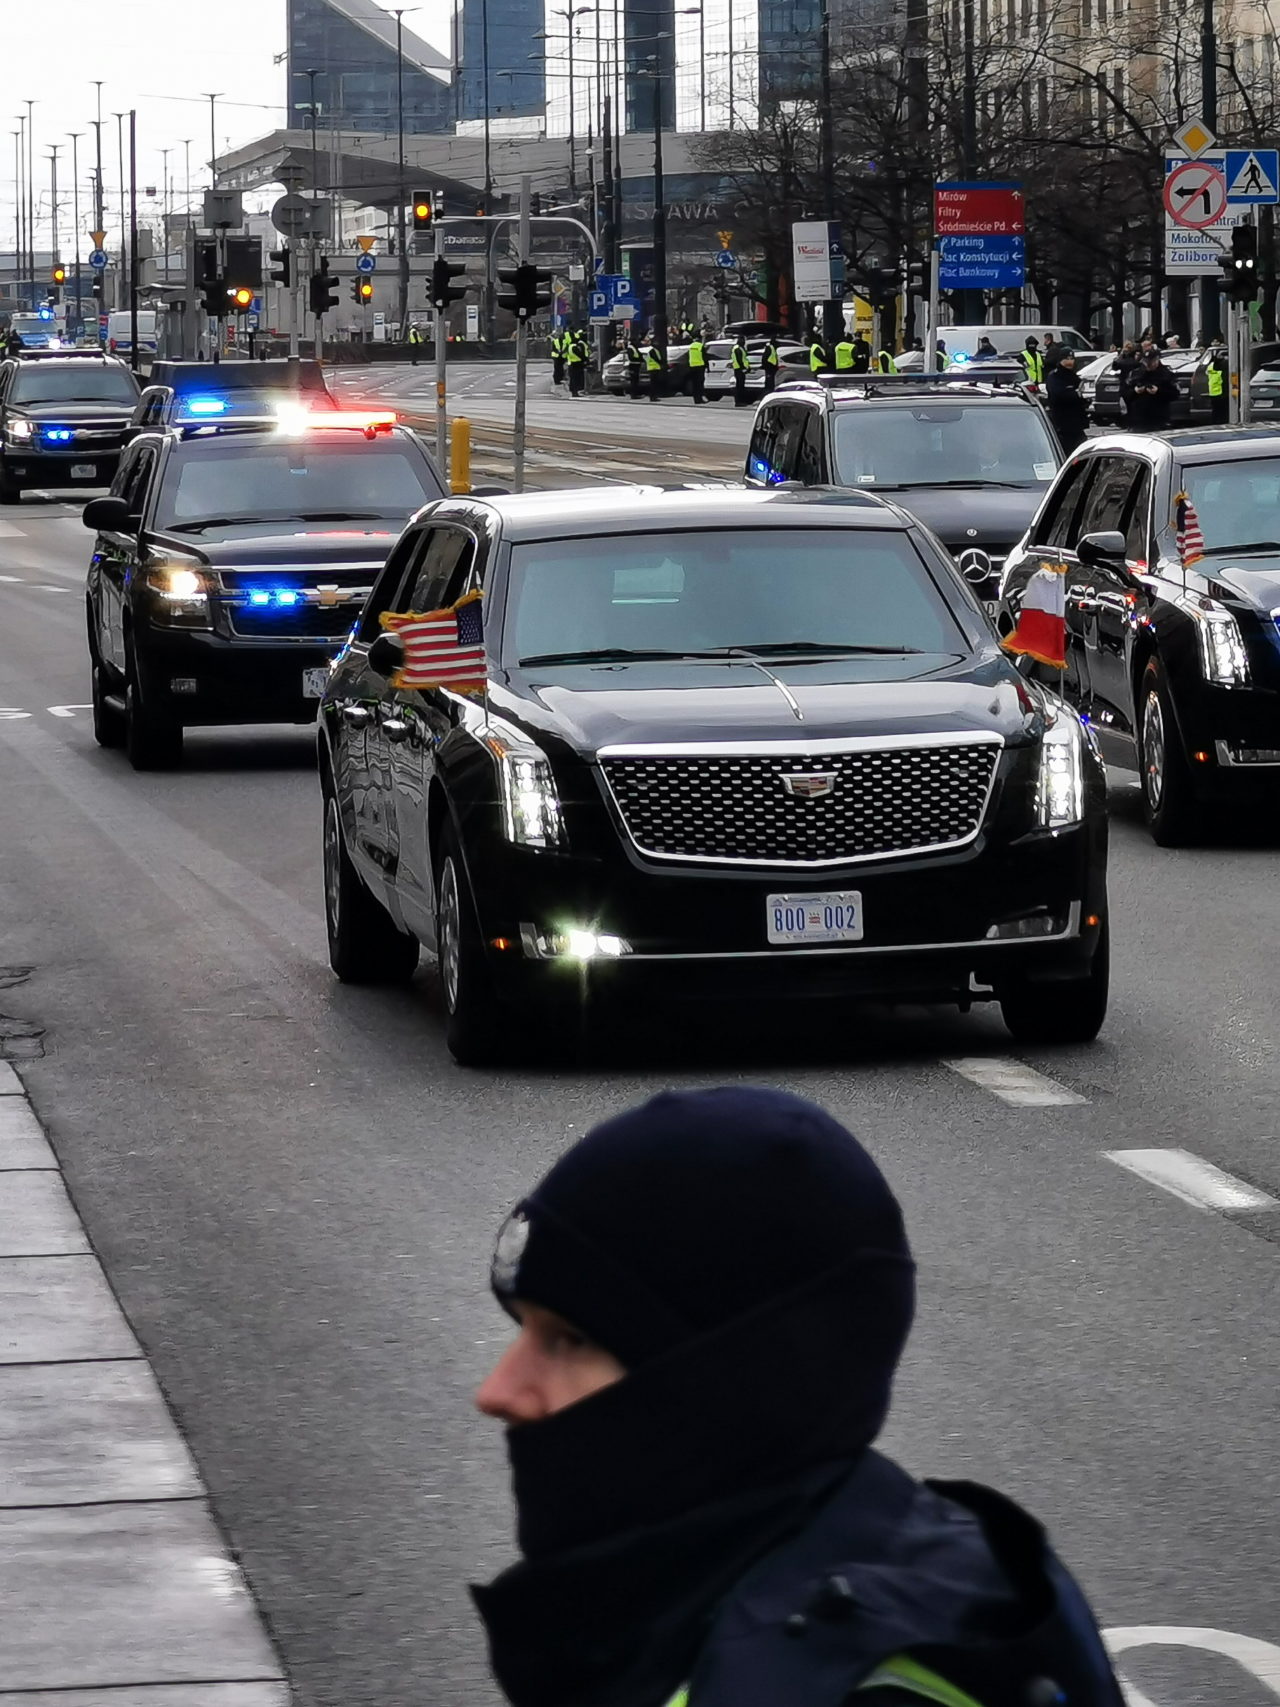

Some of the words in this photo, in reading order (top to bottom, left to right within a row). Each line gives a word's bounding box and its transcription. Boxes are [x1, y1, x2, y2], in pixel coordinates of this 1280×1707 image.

[938, 191, 967, 201] Mirów
[938, 206, 962, 219] Filtry
[938, 221, 992, 232] Śródmieście
[950, 237, 984, 249] Parking
[959, 252, 1009, 263] Konstytucji
[958, 267, 1000, 279] Bankowy
[617, 280, 630, 297] P
[593, 293, 606, 310] P
[774, 907, 806, 932] 800
[824, 904, 856, 929] 002
